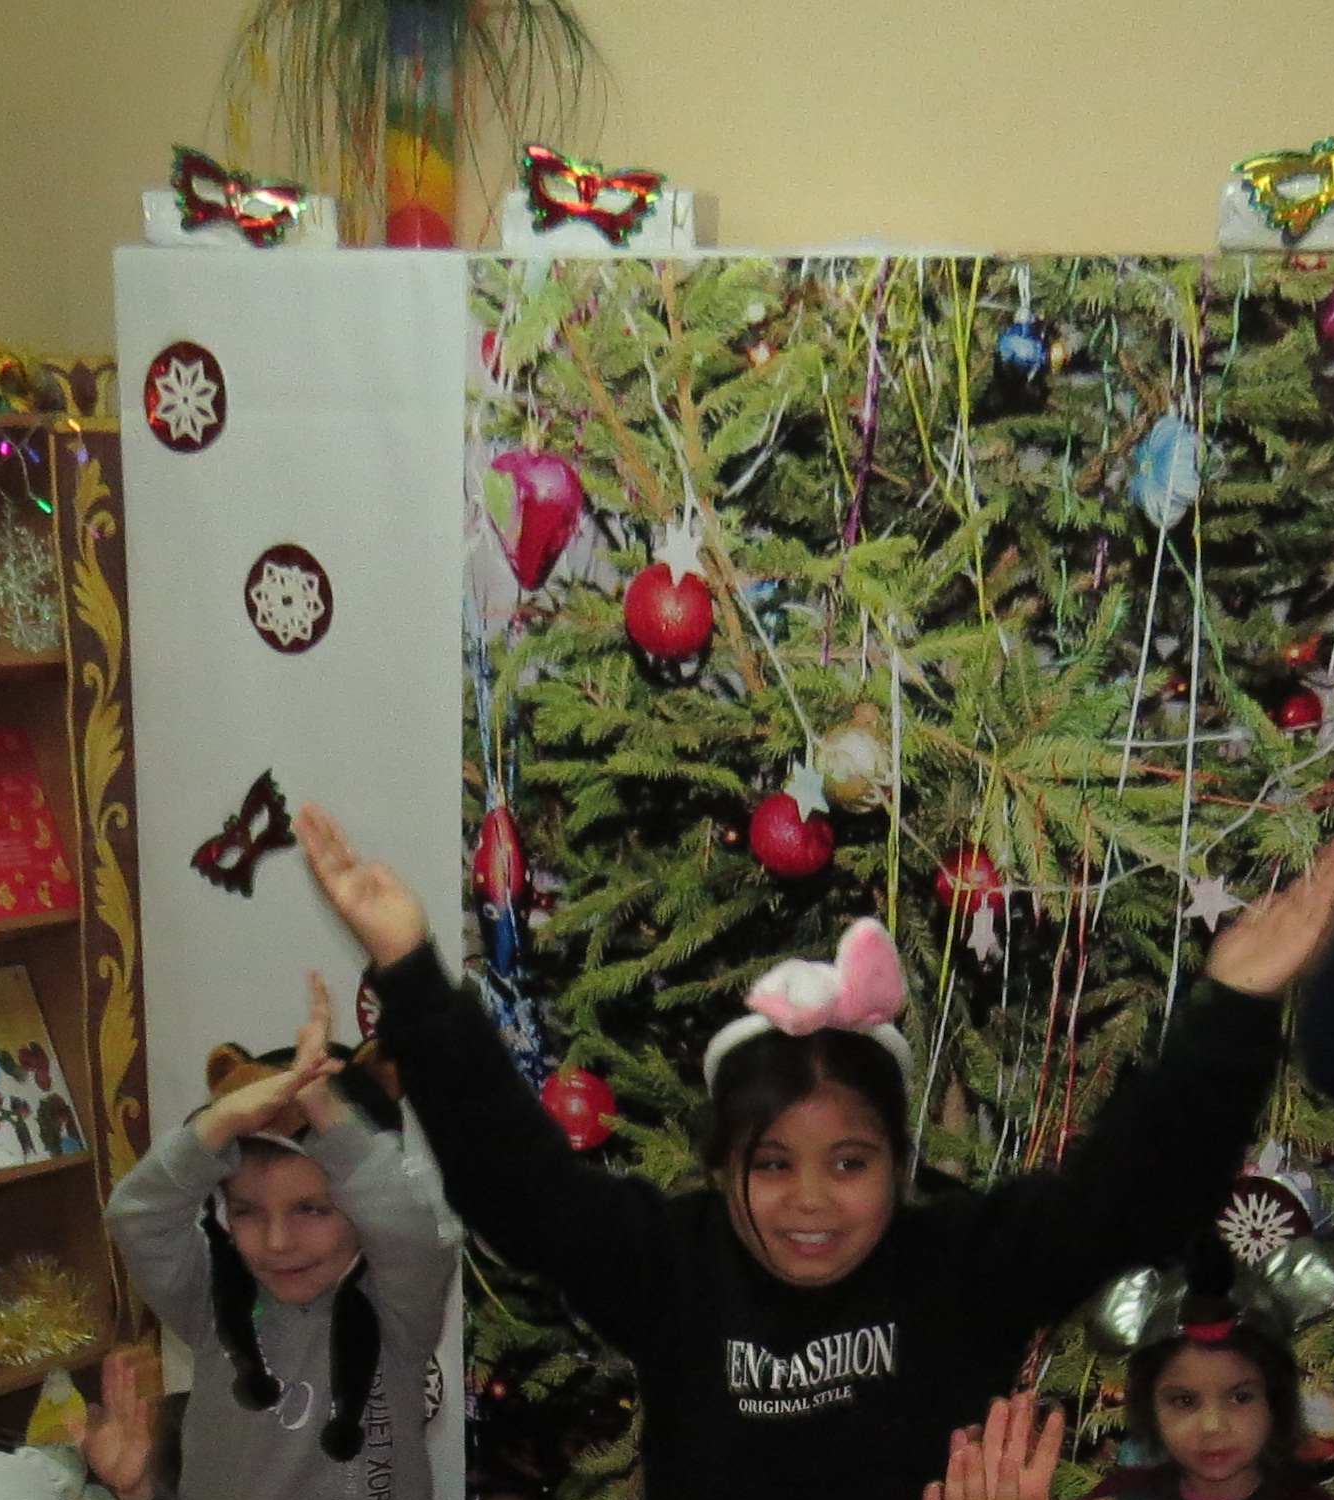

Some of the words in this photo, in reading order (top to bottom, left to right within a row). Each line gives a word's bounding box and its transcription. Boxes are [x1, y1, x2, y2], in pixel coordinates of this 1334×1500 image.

[771, 1322, 896, 1389] FASHION
[738, 1398, 810, 1414] ORIGINAL
[813, 1385, 852, 1407] STYLE
